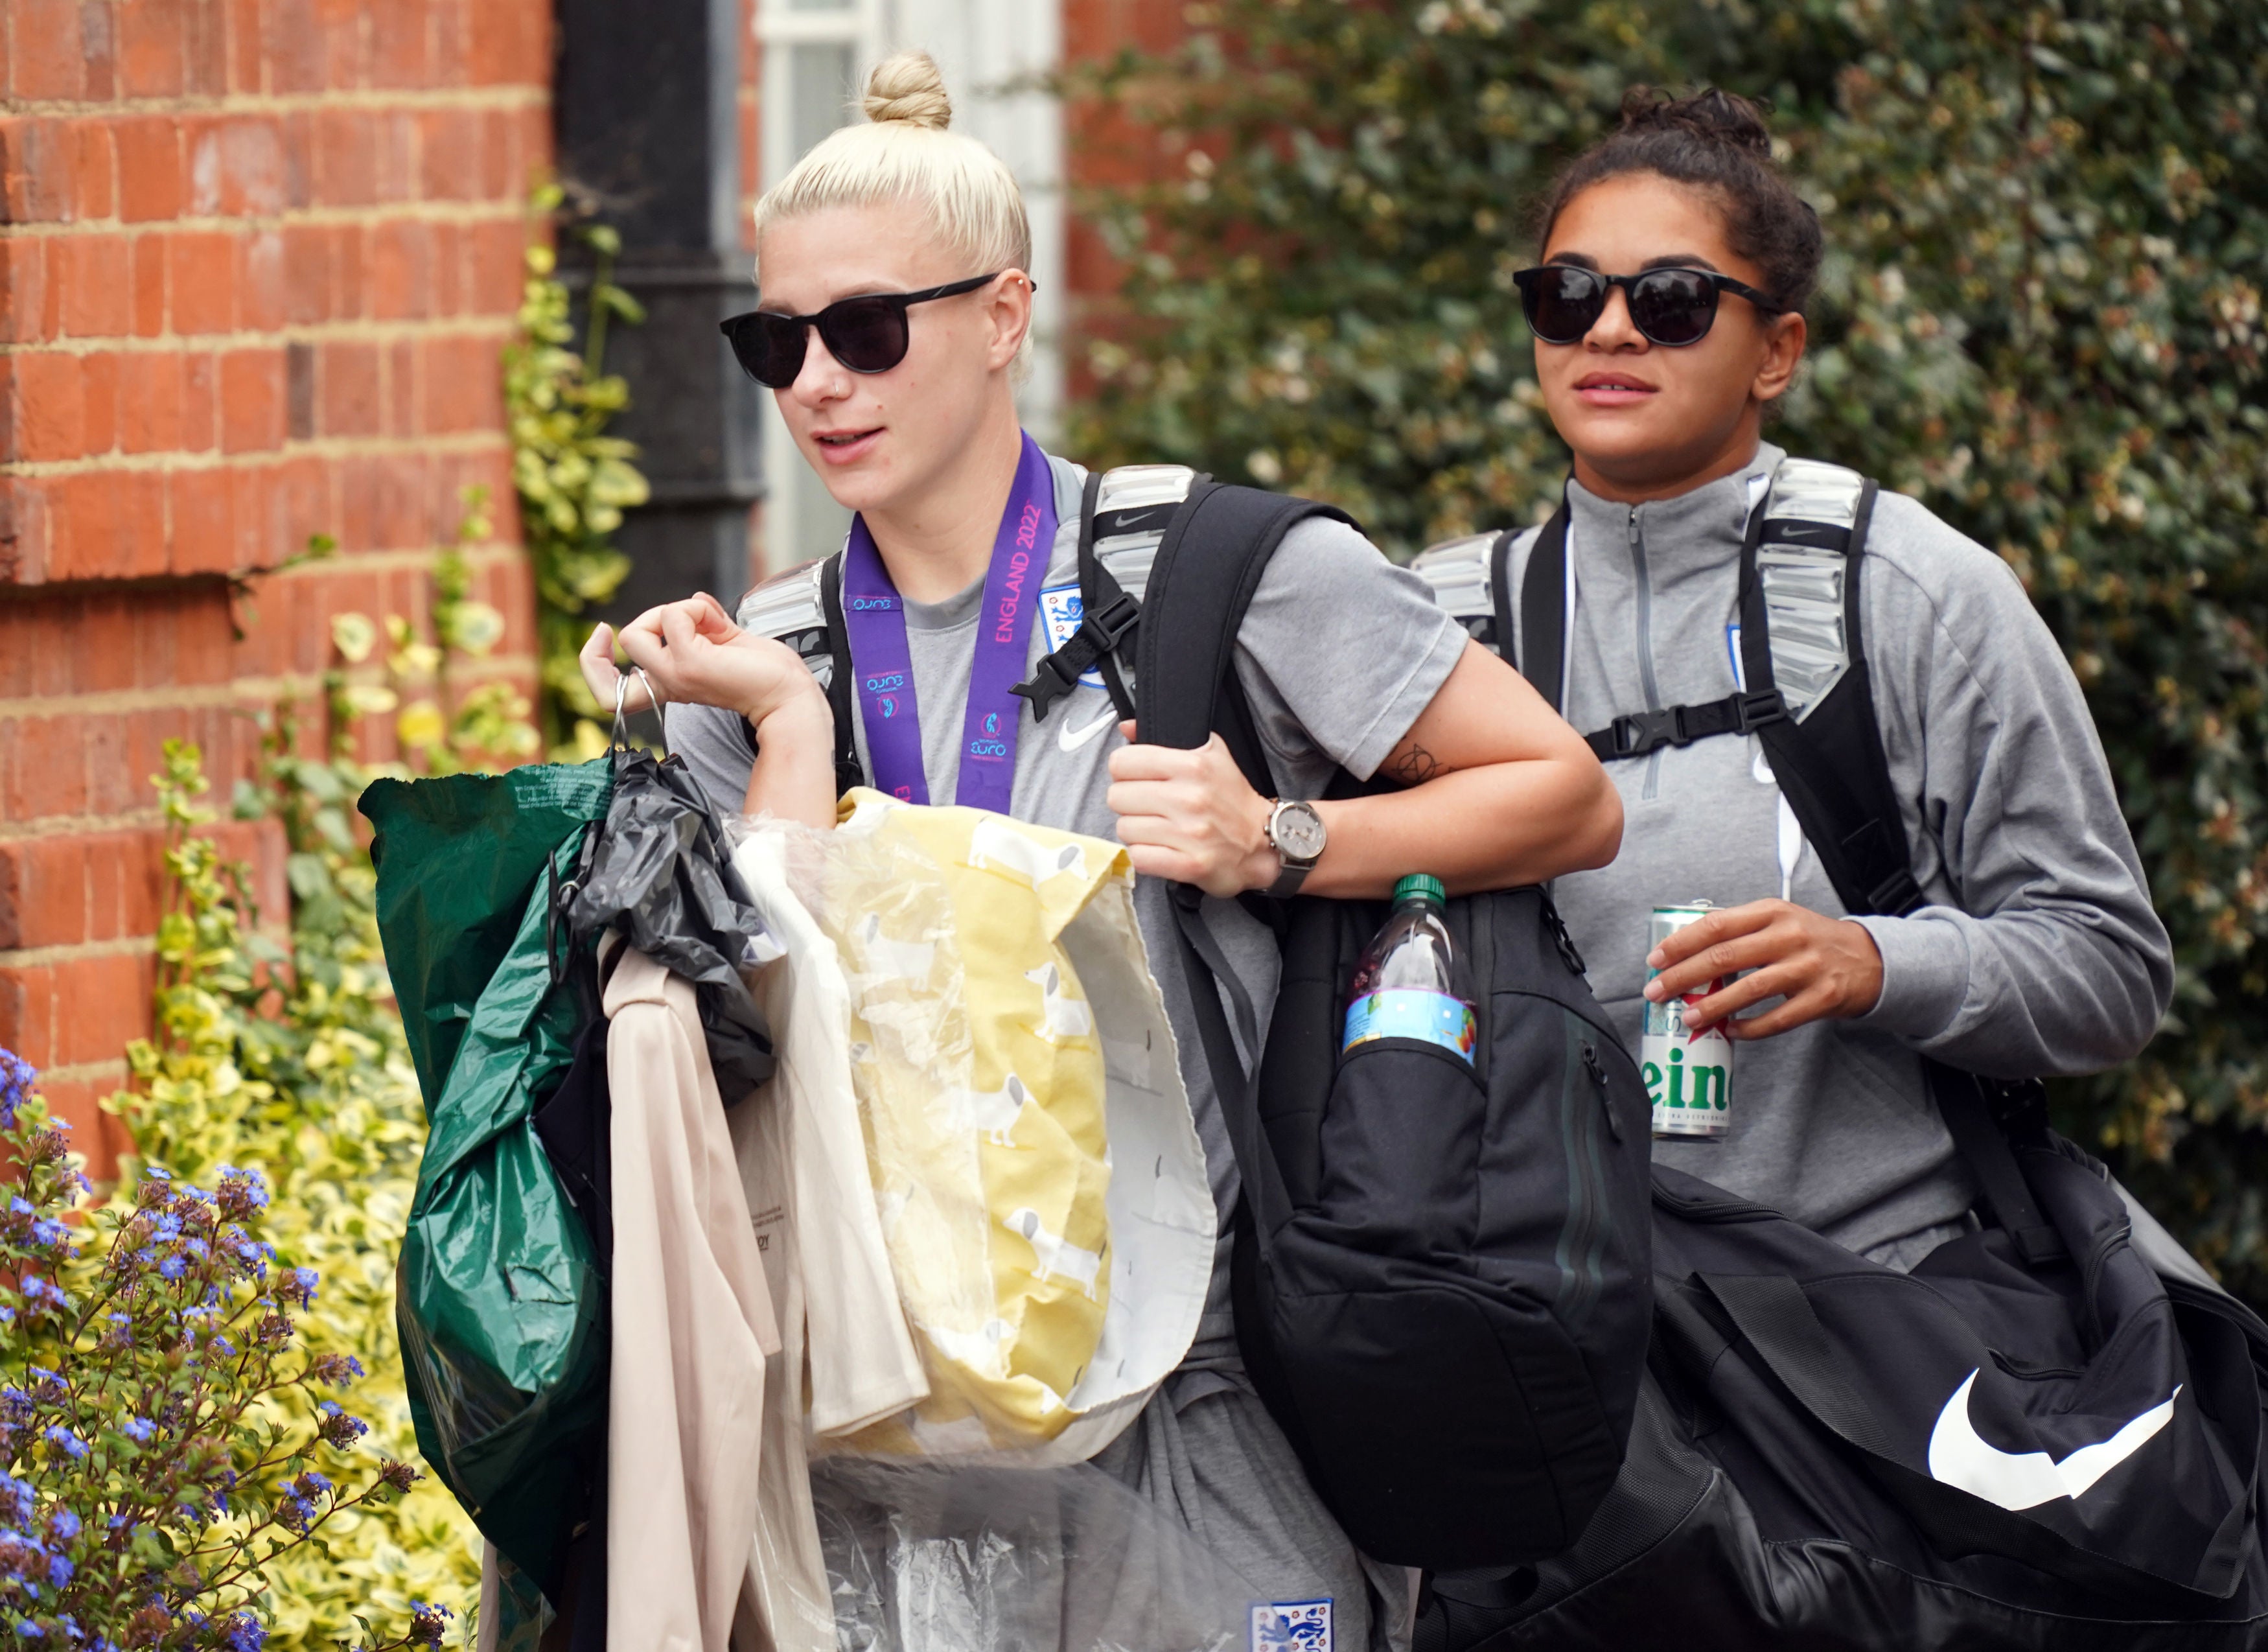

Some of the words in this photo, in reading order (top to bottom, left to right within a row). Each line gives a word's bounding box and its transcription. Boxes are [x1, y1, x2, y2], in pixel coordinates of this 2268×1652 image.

[995, 552, 1030, 644] ENGLAND
[1016, 504, 1041, 550] 2022
[1641, 1047, 1733, 1111] ein
